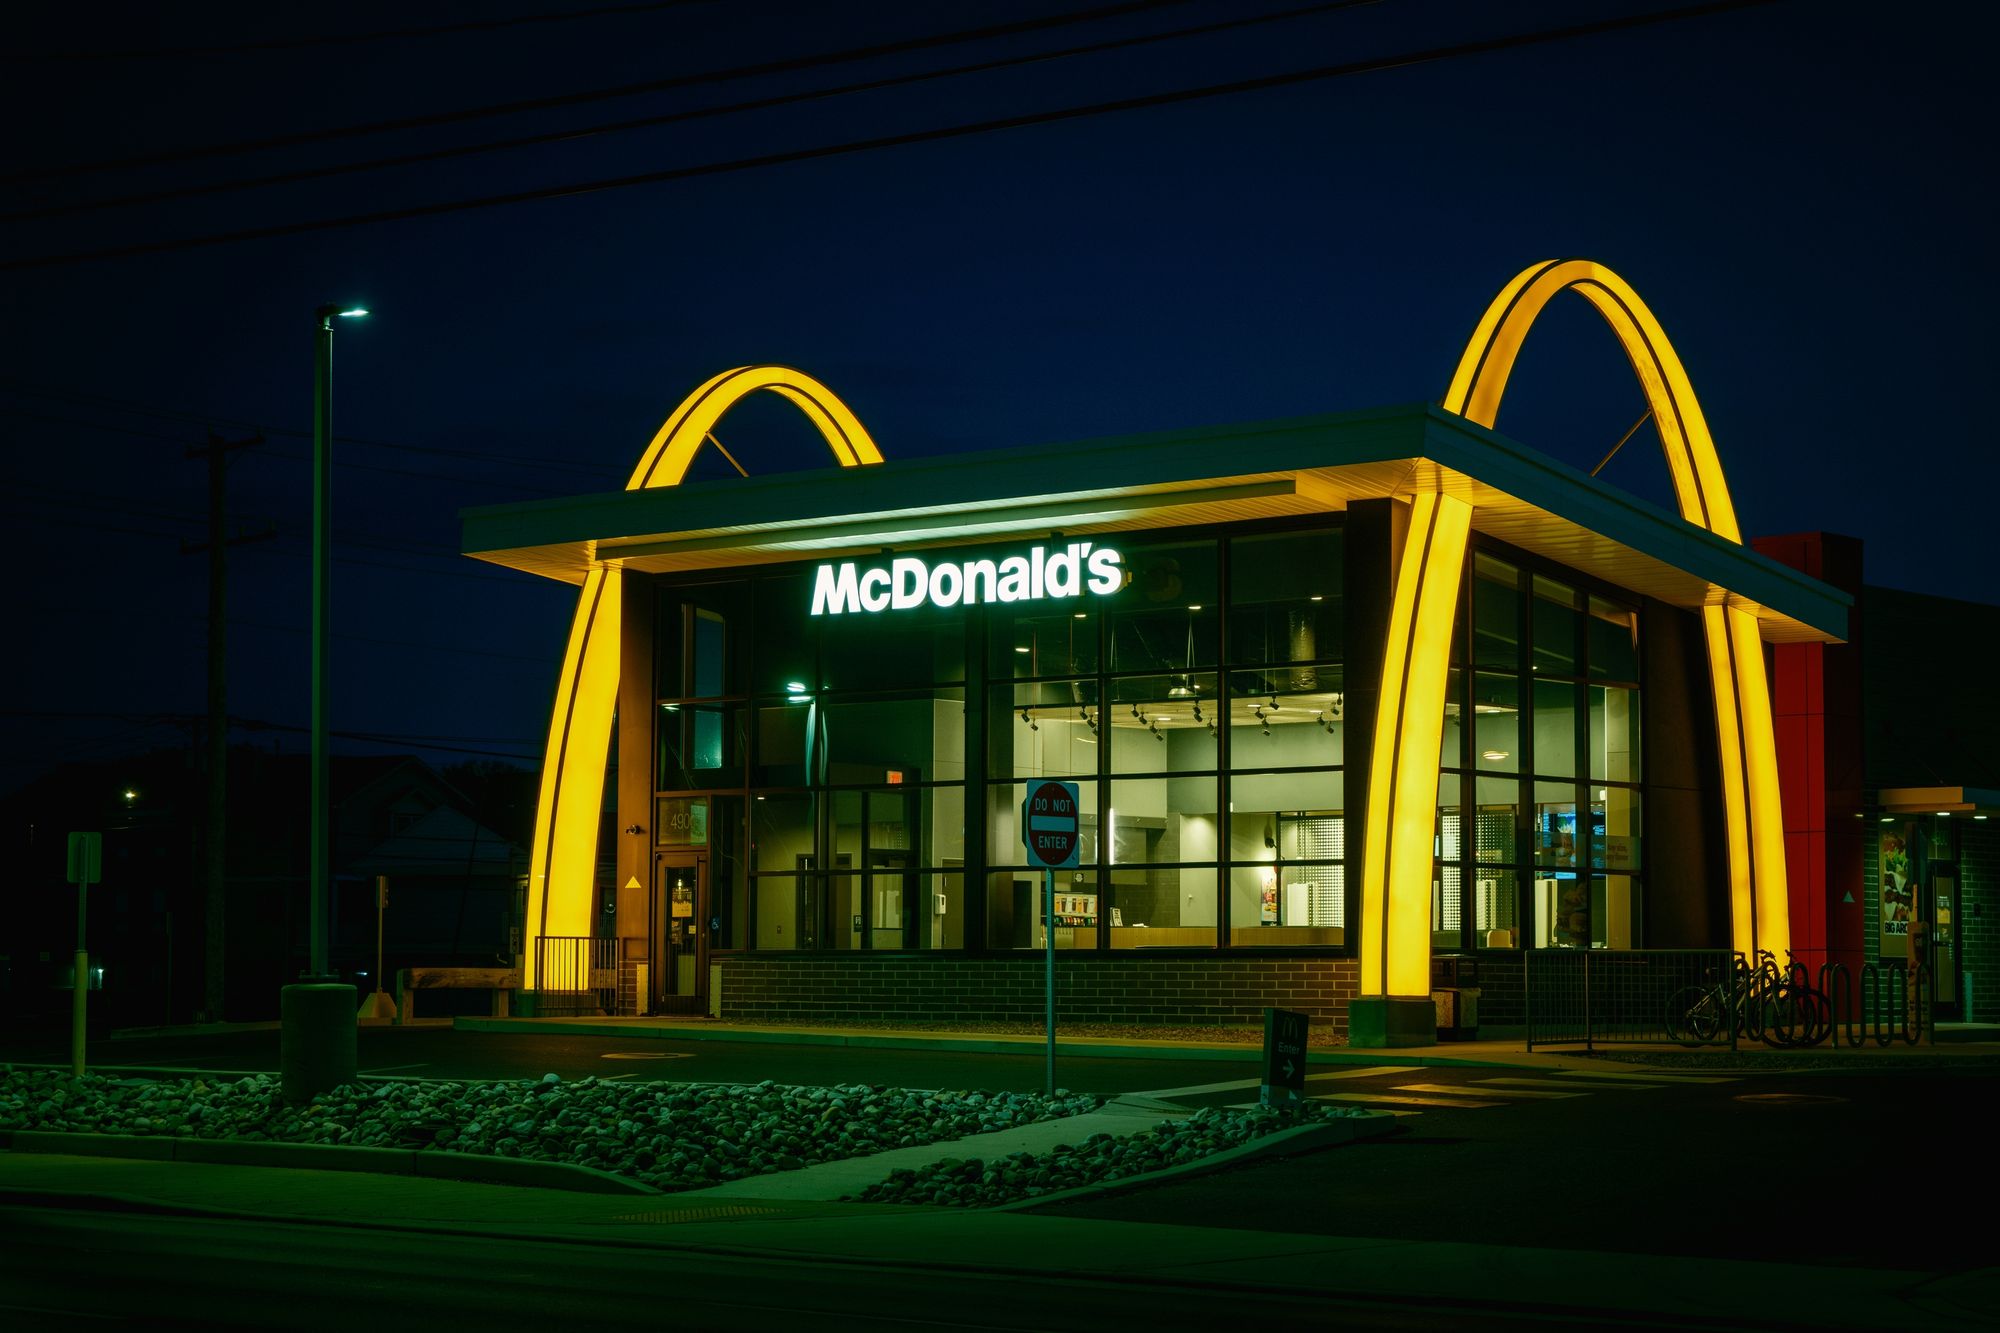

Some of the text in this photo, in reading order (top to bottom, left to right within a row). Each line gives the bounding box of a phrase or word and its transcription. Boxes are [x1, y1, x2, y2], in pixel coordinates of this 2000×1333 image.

[810, 542, 1122, 616] McDonald's
[1035, 798, 1071, 813] DO NOT
[1038, 835, 1068, 850] ENTER
[1885, 922, 1895, 933] BIG
[1278, 1042, 1300, 1055] Enter
